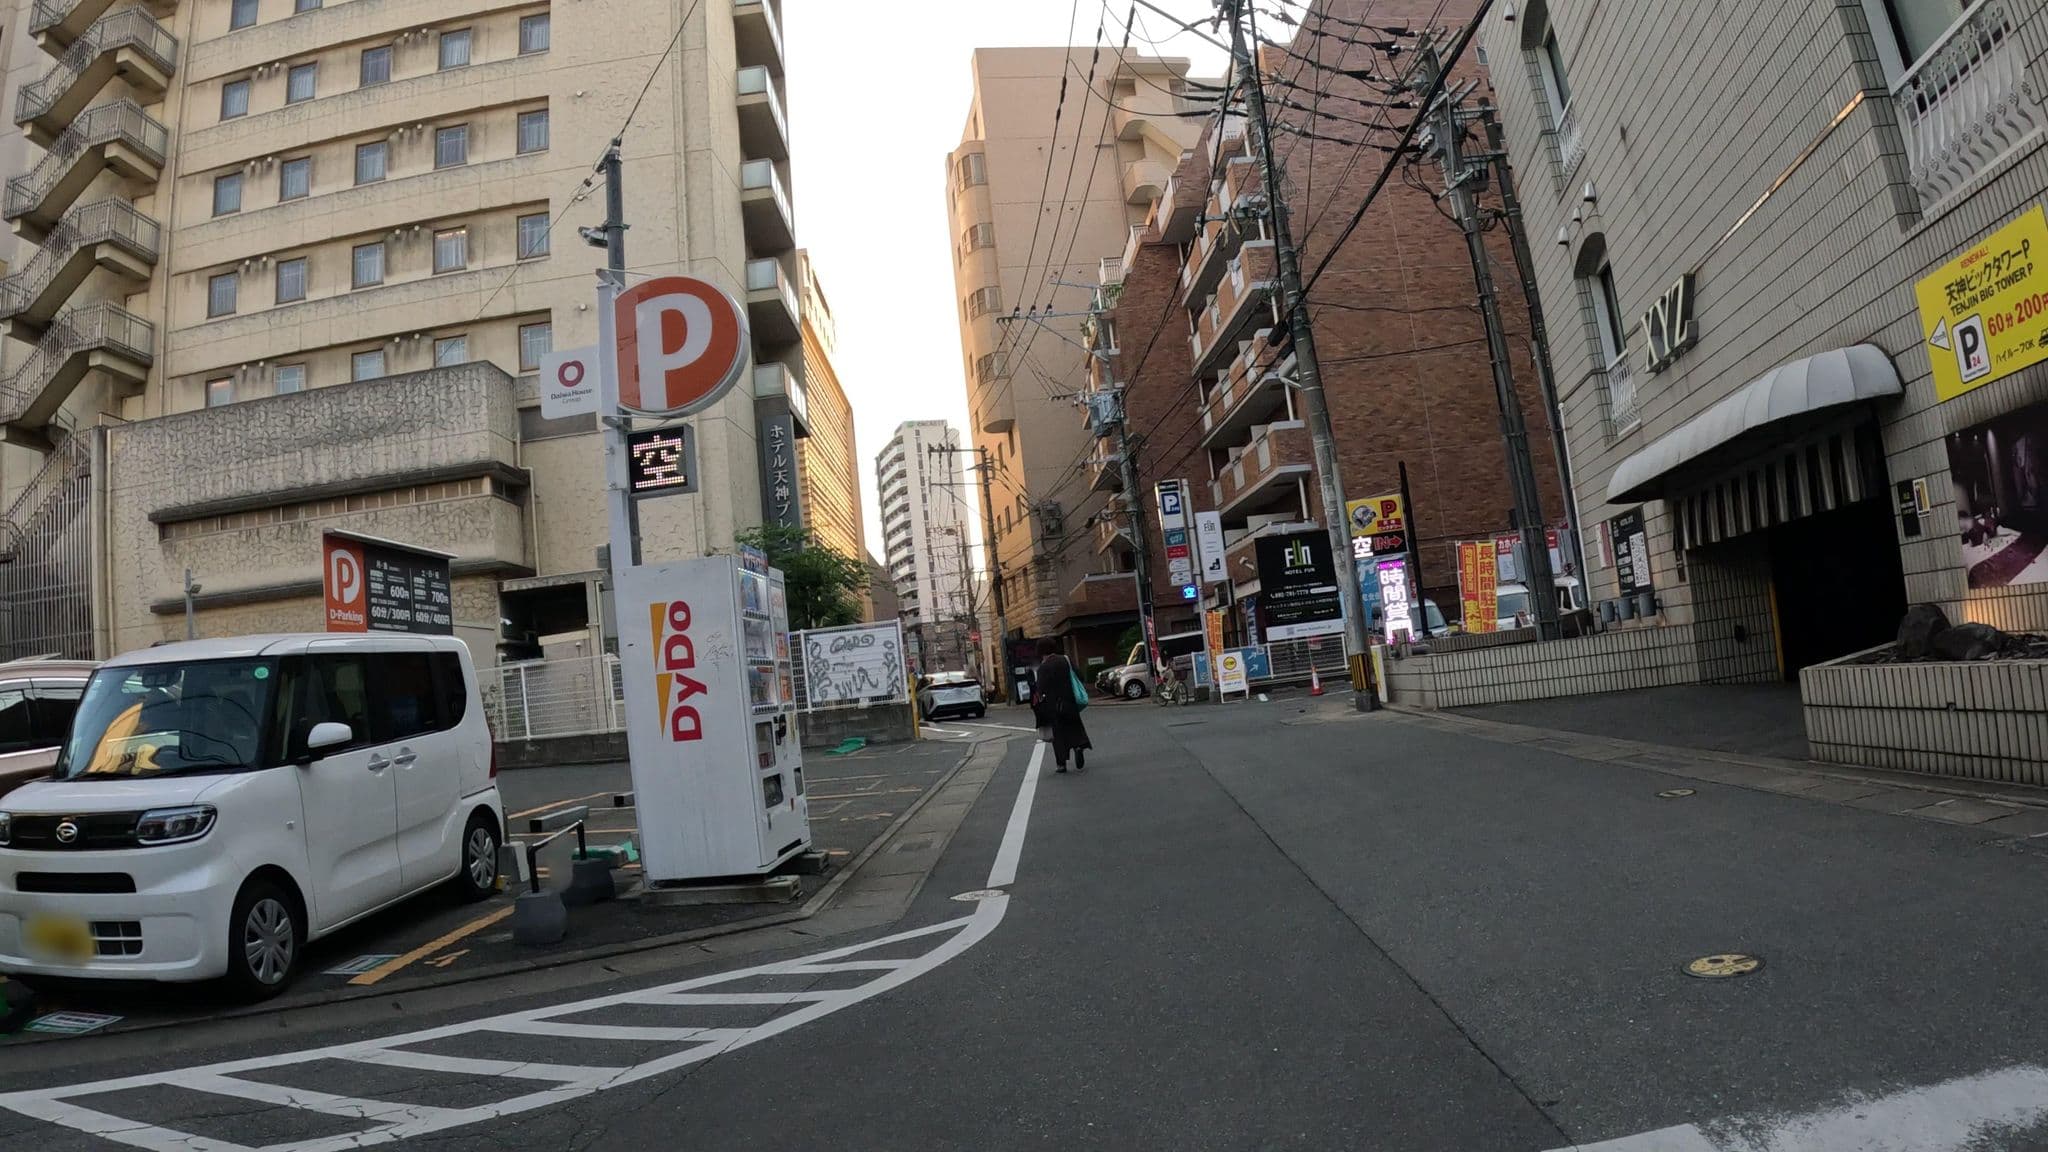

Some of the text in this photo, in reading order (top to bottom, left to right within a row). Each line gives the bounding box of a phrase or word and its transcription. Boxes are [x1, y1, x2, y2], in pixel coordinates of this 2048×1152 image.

[1950, 262, 2034, 318] TENJIN BIG TOWER P
[1640, 273, 1692, 374] XYZ
[1959, 325, 1979, 370] P
[1988, 312, 2014, 336] 60分
[636, 293, 713, 410] P
[1971, 356, 1982, 368] 24
[632, 434, 685, 489] 空
[1165, 494, 1179, 513] P
[1380, 499, 1397, 518] P
[1352, 535, 1374, 559] 空
[330, 549, 360, 604] P
[664, 600, 707, 742] DyDo
